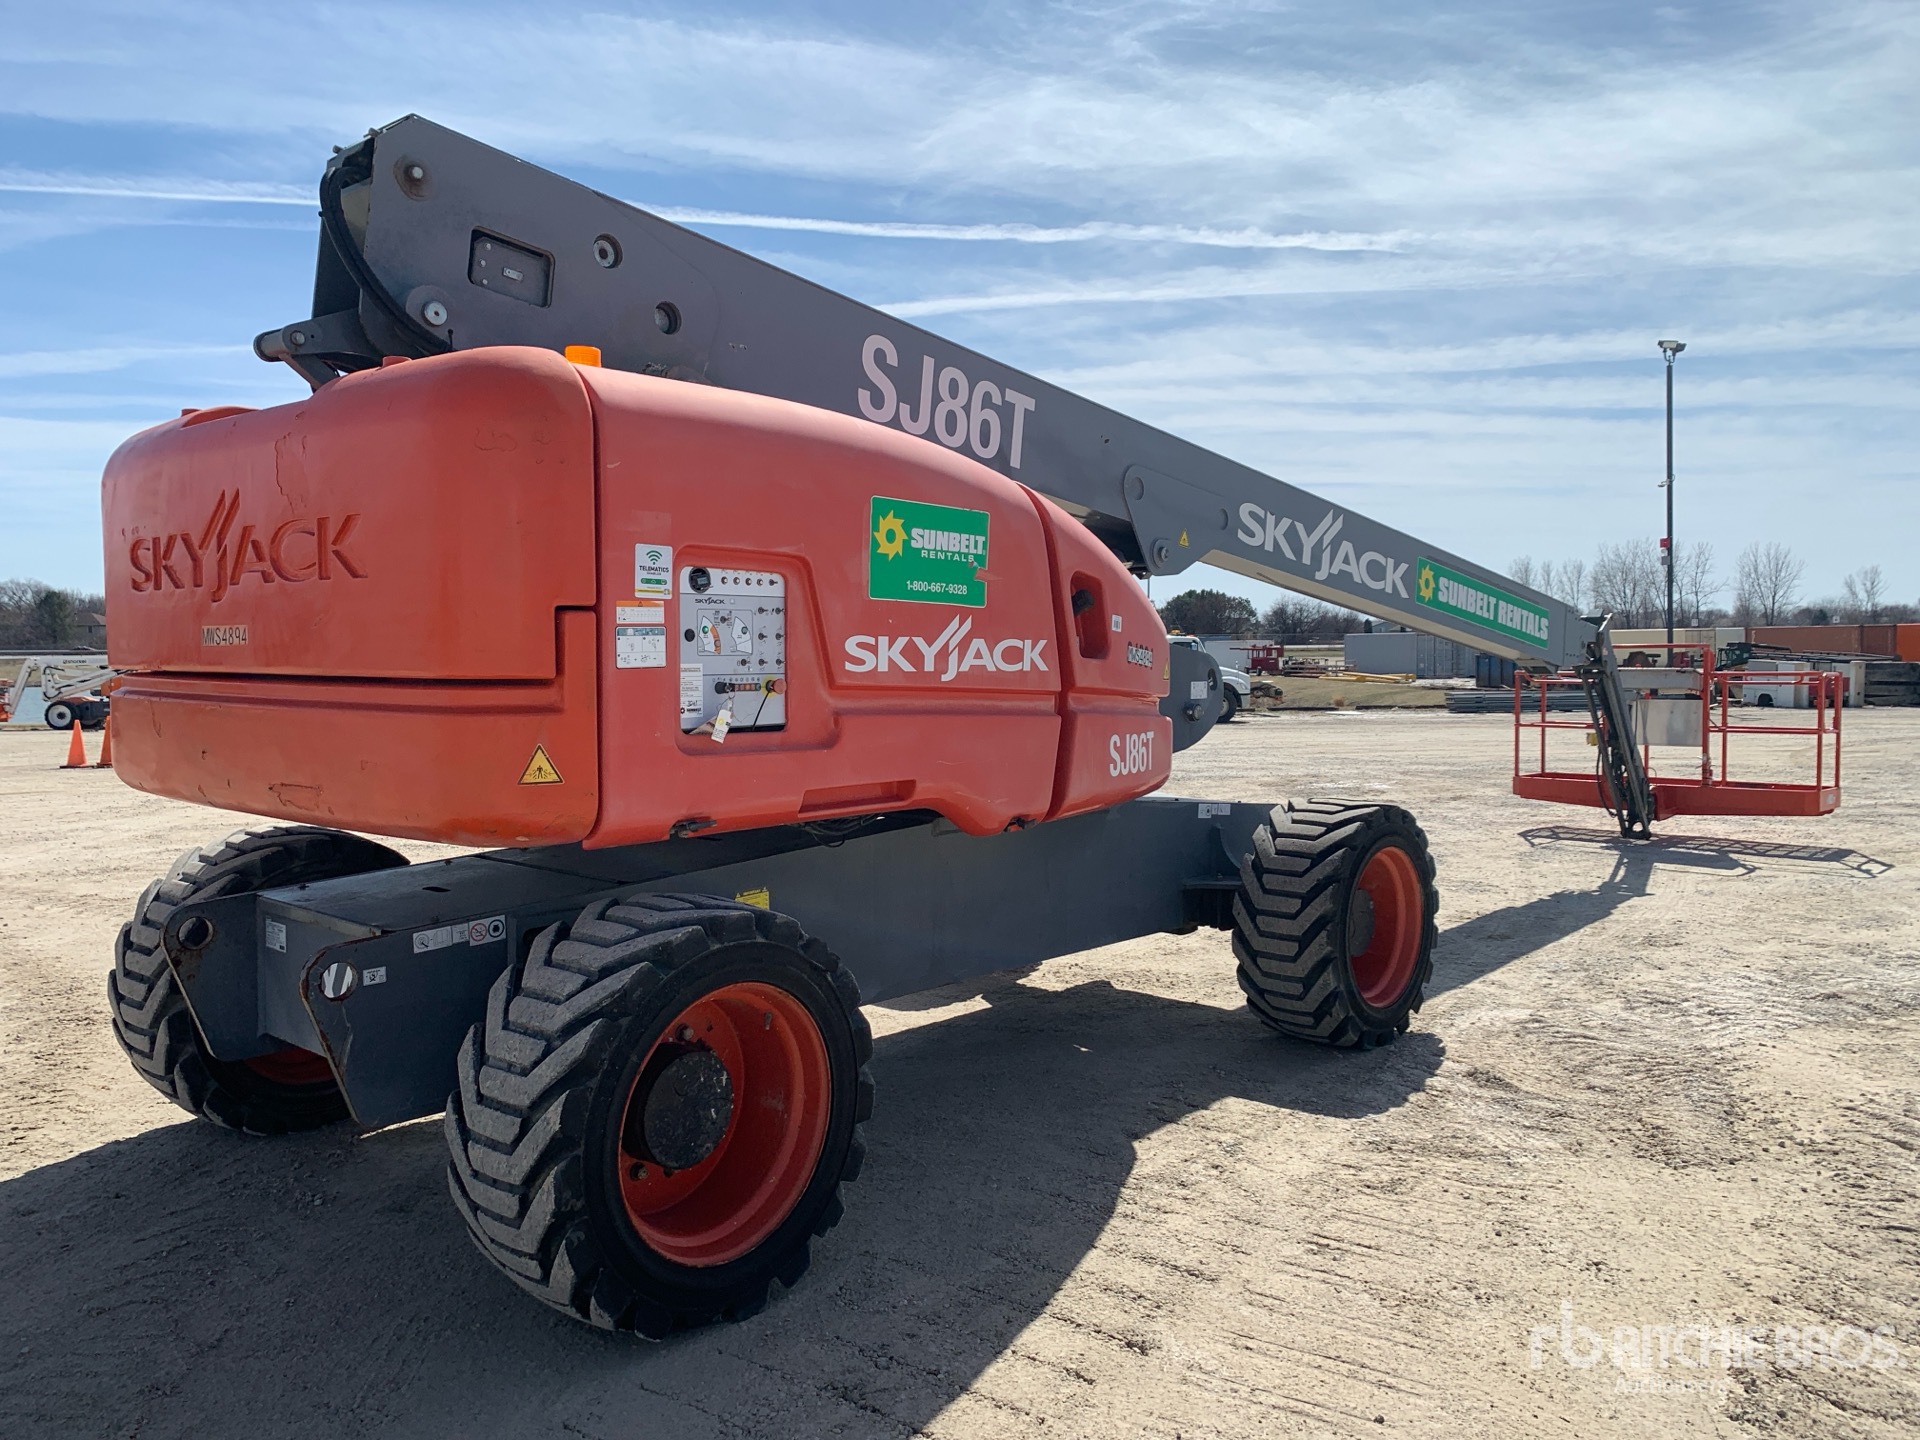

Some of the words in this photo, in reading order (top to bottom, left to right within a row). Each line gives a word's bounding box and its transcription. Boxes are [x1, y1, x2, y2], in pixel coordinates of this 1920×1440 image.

[858, 334, 1036, 469] SJ86T
[130, 488, 369, 603] SKYJACK
[911, 527, 986, 555] SUNBELT
[921, 549, 974, 562] RENTALS
[1238, 502, 1410, 599] SKYJACK
[639, 565, 670, 573] TELEMATICS
[906, 580, 968, 595] 1-800-667-9328
[695, 597, 726, 605] SKYJACK
[1438, 576, 1497, 620] SUNBELT
[1498, 600, 1549, 641] RENTALS
[202, 626, 247, 645] MWS4894
[844, 613, 1049, 682] SKYJACK
[1109, 731, 1155, 777] SJ86T
